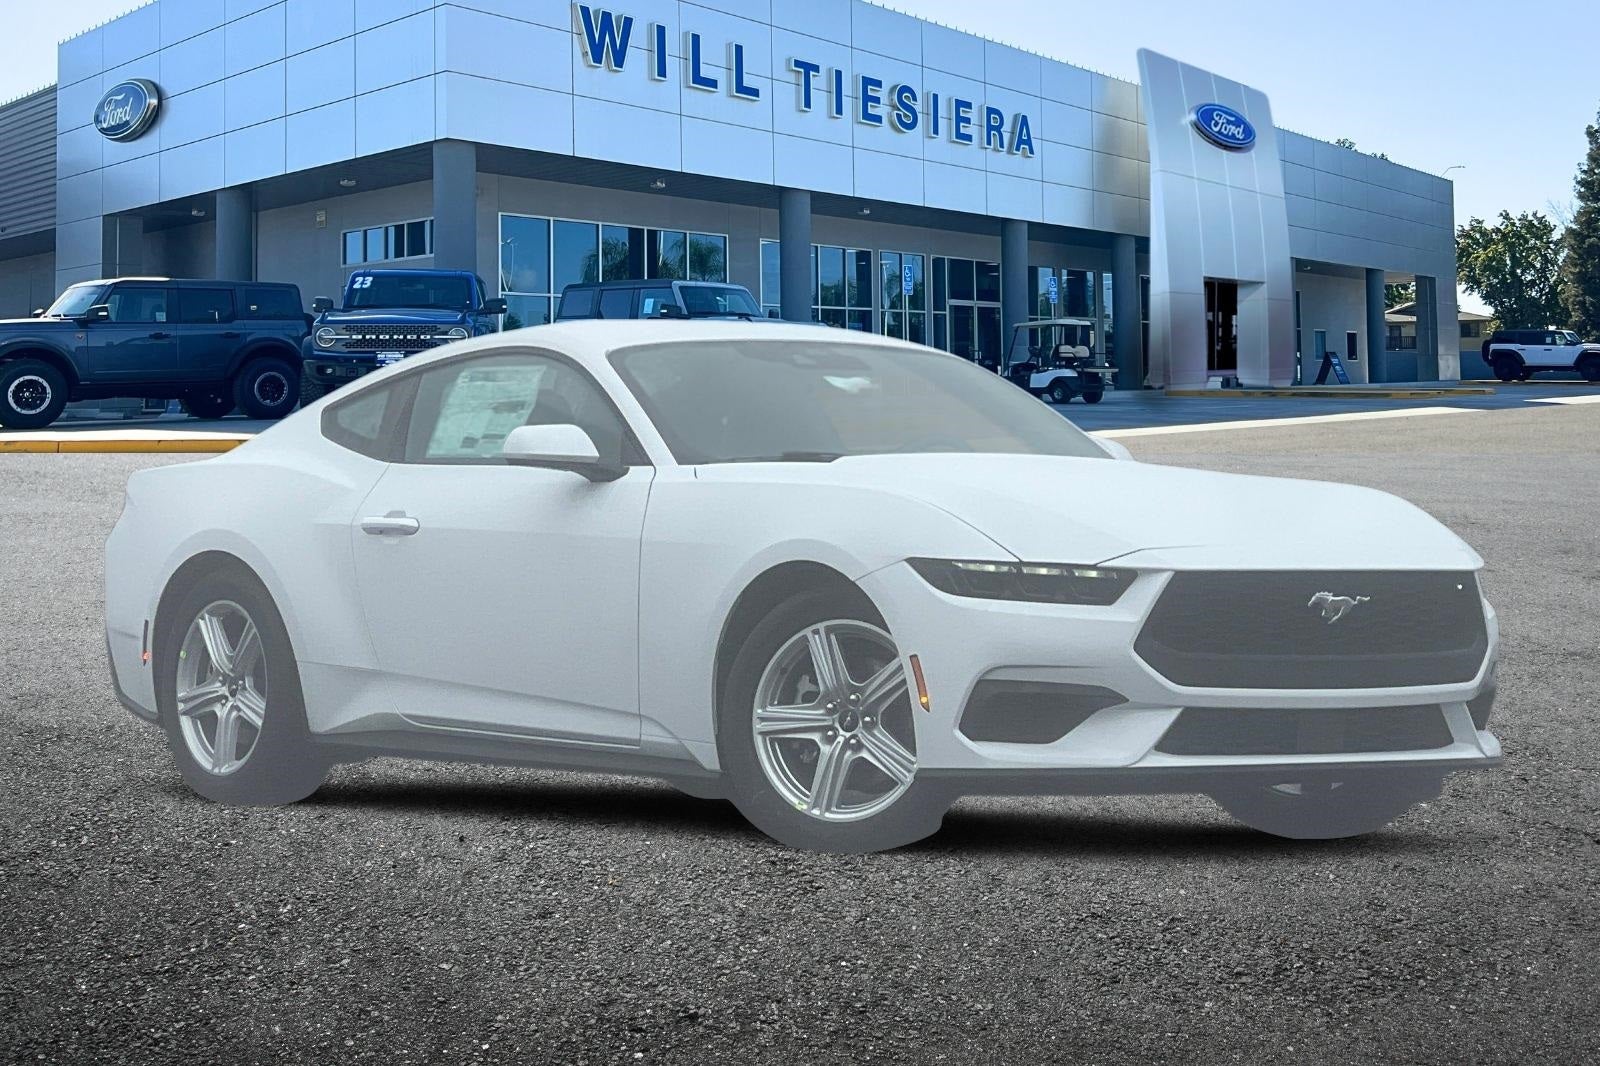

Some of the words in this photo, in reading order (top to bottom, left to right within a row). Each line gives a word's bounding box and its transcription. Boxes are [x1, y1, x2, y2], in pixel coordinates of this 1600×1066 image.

[576, 3, 760, 100] WILL
[787, 57, 1035, 157] TIESIERA
[101, 93, 133, 128] Ford
[1211, 110, 1245, 139] Ford
[352, 276, 373, 289] 23
